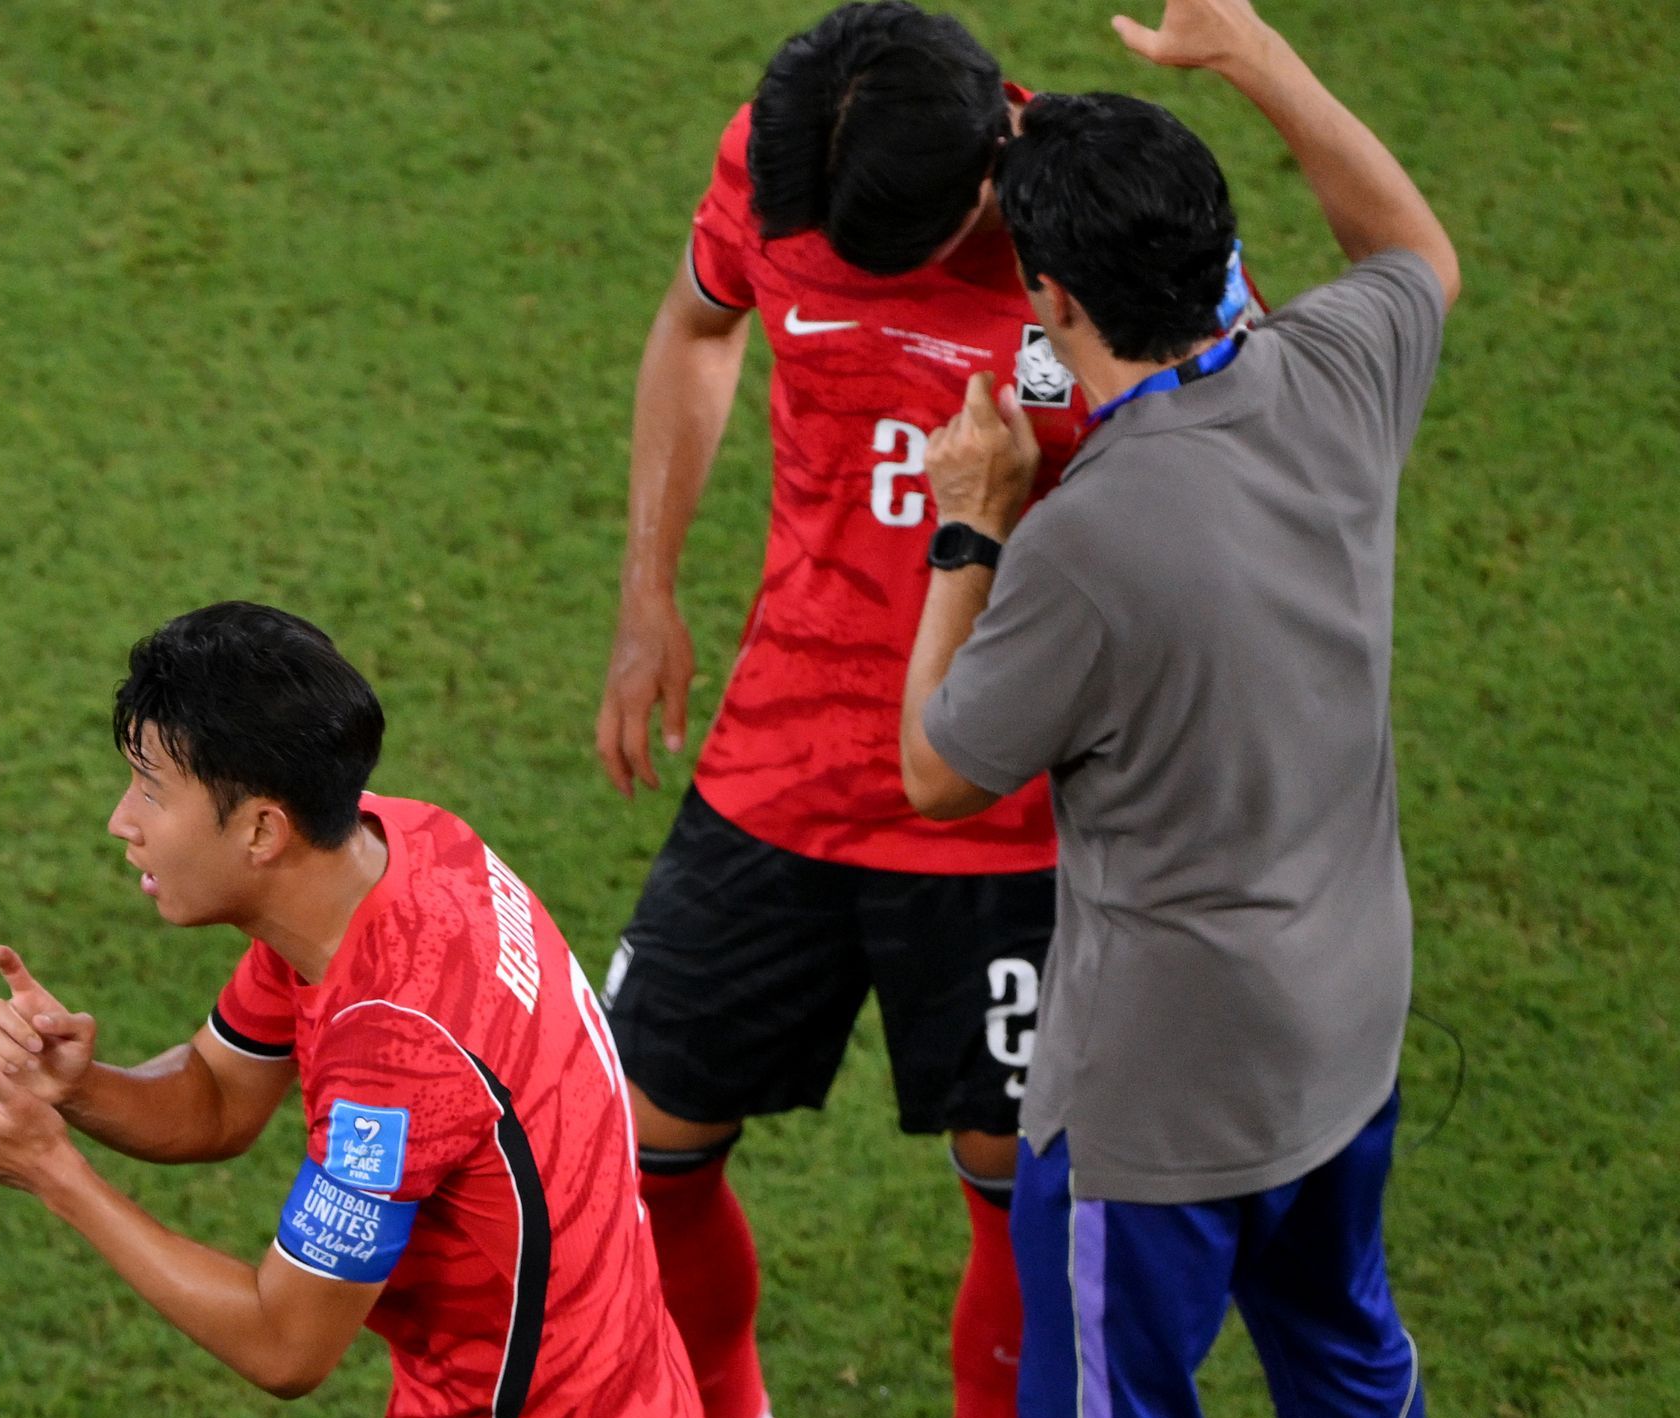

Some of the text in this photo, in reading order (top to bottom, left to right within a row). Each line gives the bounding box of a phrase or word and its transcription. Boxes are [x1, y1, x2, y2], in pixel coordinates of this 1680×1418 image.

[343, 1154, 381, 1173] PEACE
[349, 1170, 370, 1181] FIFA
[303, 1188, 379, 1242] UNITES
[313, 1174, 381, 1222] FOOTBALL
[292, 1209, 377, 1263] the World
